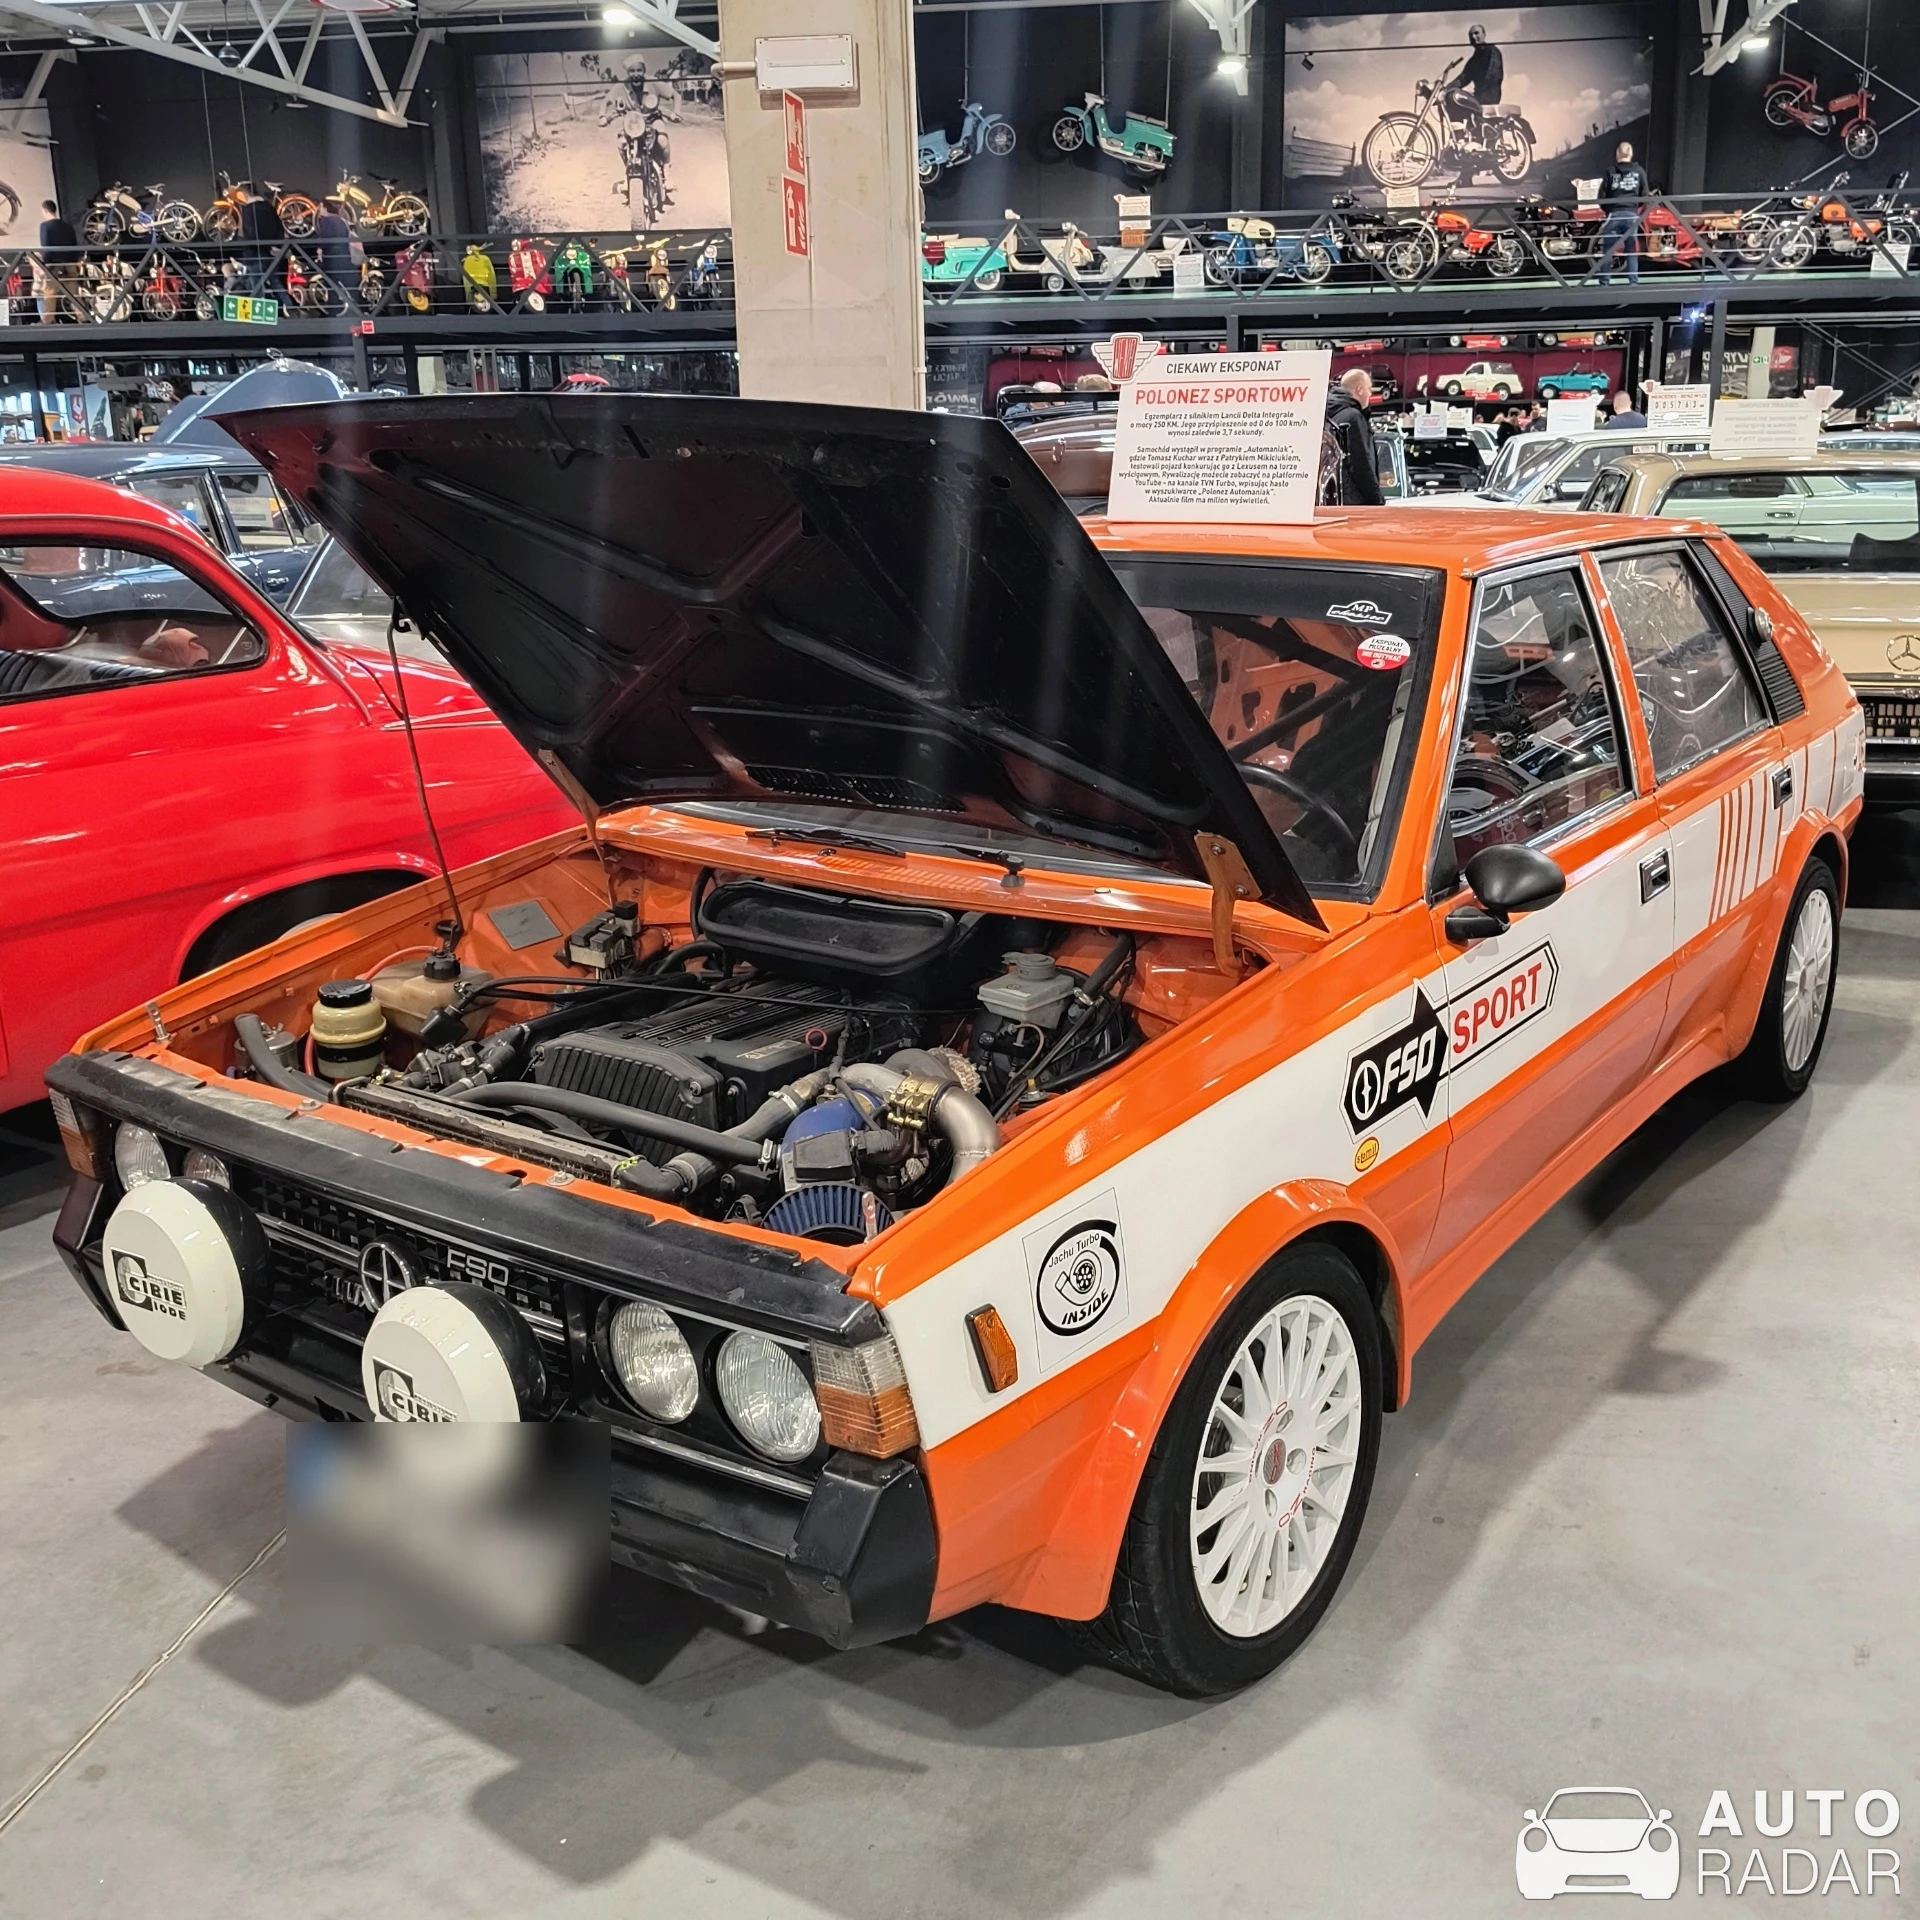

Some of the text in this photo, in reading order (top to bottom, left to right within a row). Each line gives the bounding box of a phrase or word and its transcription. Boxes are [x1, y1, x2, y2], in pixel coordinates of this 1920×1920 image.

[1166, 360, 1282, 374] CIEKAWY EKSPONAT
[1135, 386, 1308, 405] POLONEZ SPORTOWY
[1144, 413, 1183, 421] Egzemplarz
[1262, 411, 1294, 420] Integrale
[1234, 429, 1264, 437] sekundy.
[1171, 446, 1198, 454] wystąpił
[1207, 446, 1242, 454] programie
[1351, 604, 1374, 613] MP
[1368, 644, 1402, 652] MUZEALNY
[1371, 638, 1404, 648] EKSPONAT
[1452, 961, 1543, 1055] SPORT
[1381, 1025, 1438, 1105] FSO
[1048, 1231, 1101, 1268] Jachu Turbo
[446, 1248, 509, 1287] FSO
[129, 1276, 184, 1306] CIBIE
[153, 1301, 187, 1321] IODE
[1061, 1288, 1109, 1326] INSIDE
[391, 1391, 456, 1422] CIBI
